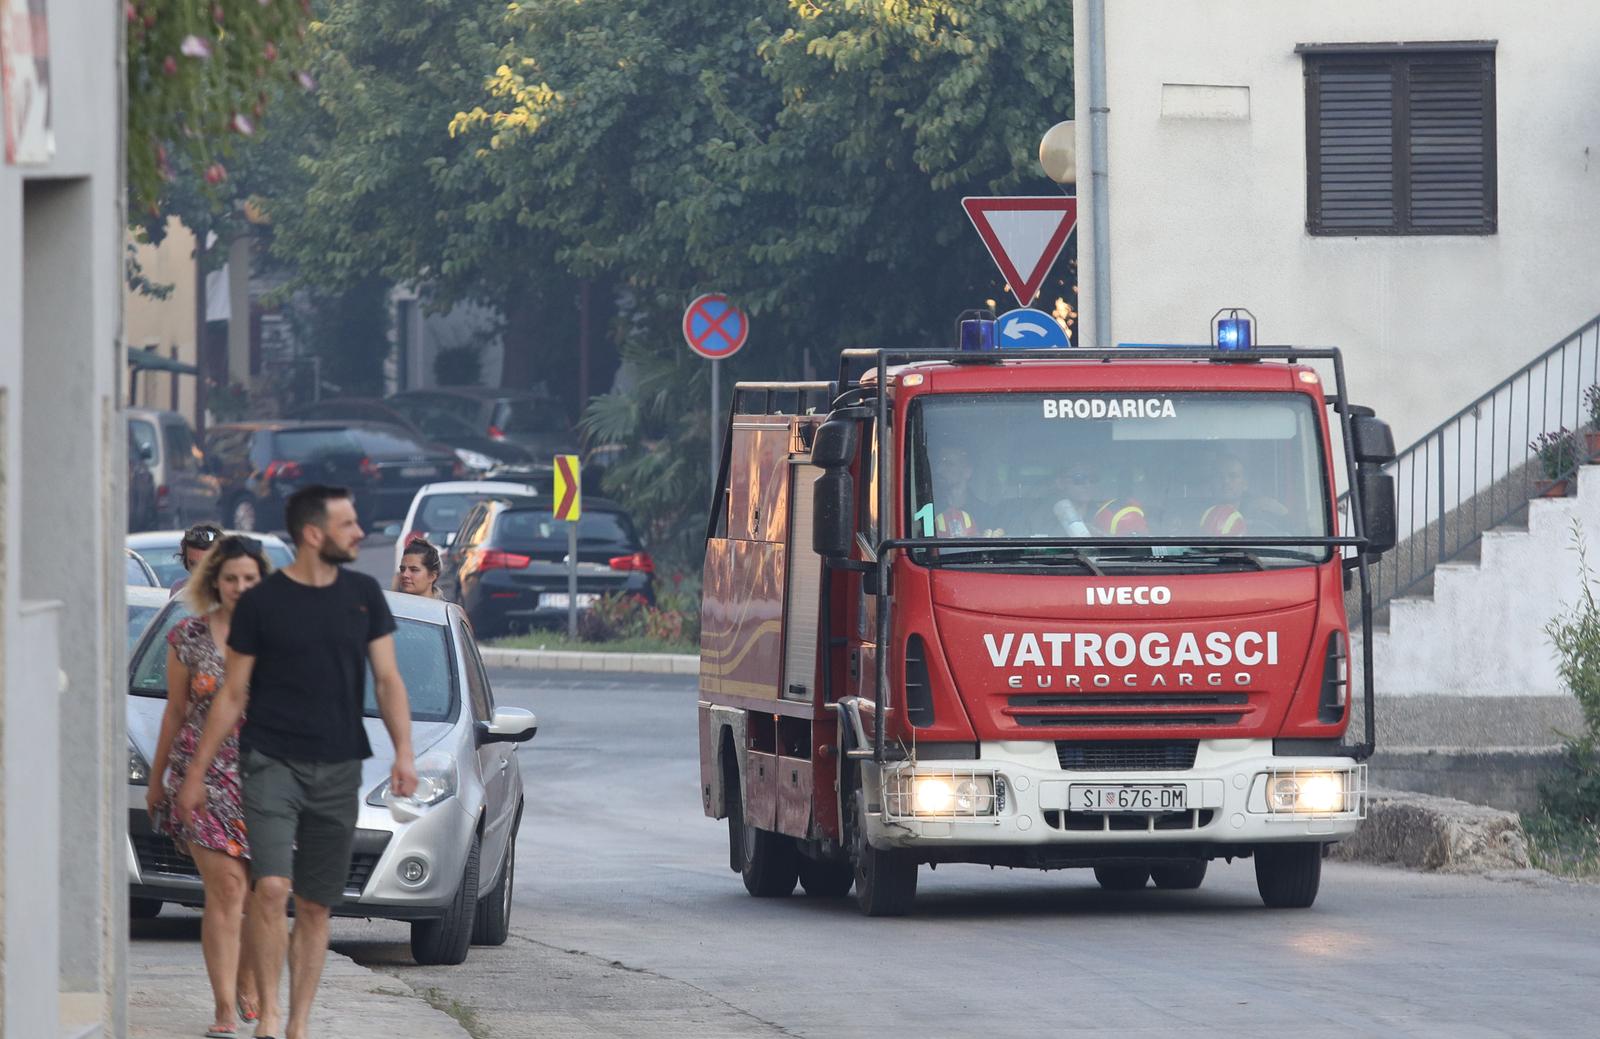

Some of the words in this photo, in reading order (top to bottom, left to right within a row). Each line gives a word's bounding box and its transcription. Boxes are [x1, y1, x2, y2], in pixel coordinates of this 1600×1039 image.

[1043, 398, 1177, 419] BRODARICA
[914, 503, 934, 537] 1
[1086, 586, 1172, 605] IVECO
[983, 631, 1278, 667] VATROGASCI
[1008, 672, 1252, 688] EUROCARGO
[1083, 789, 1101, 808] SI
[1118, 789, 1183, 808] 676-DM
